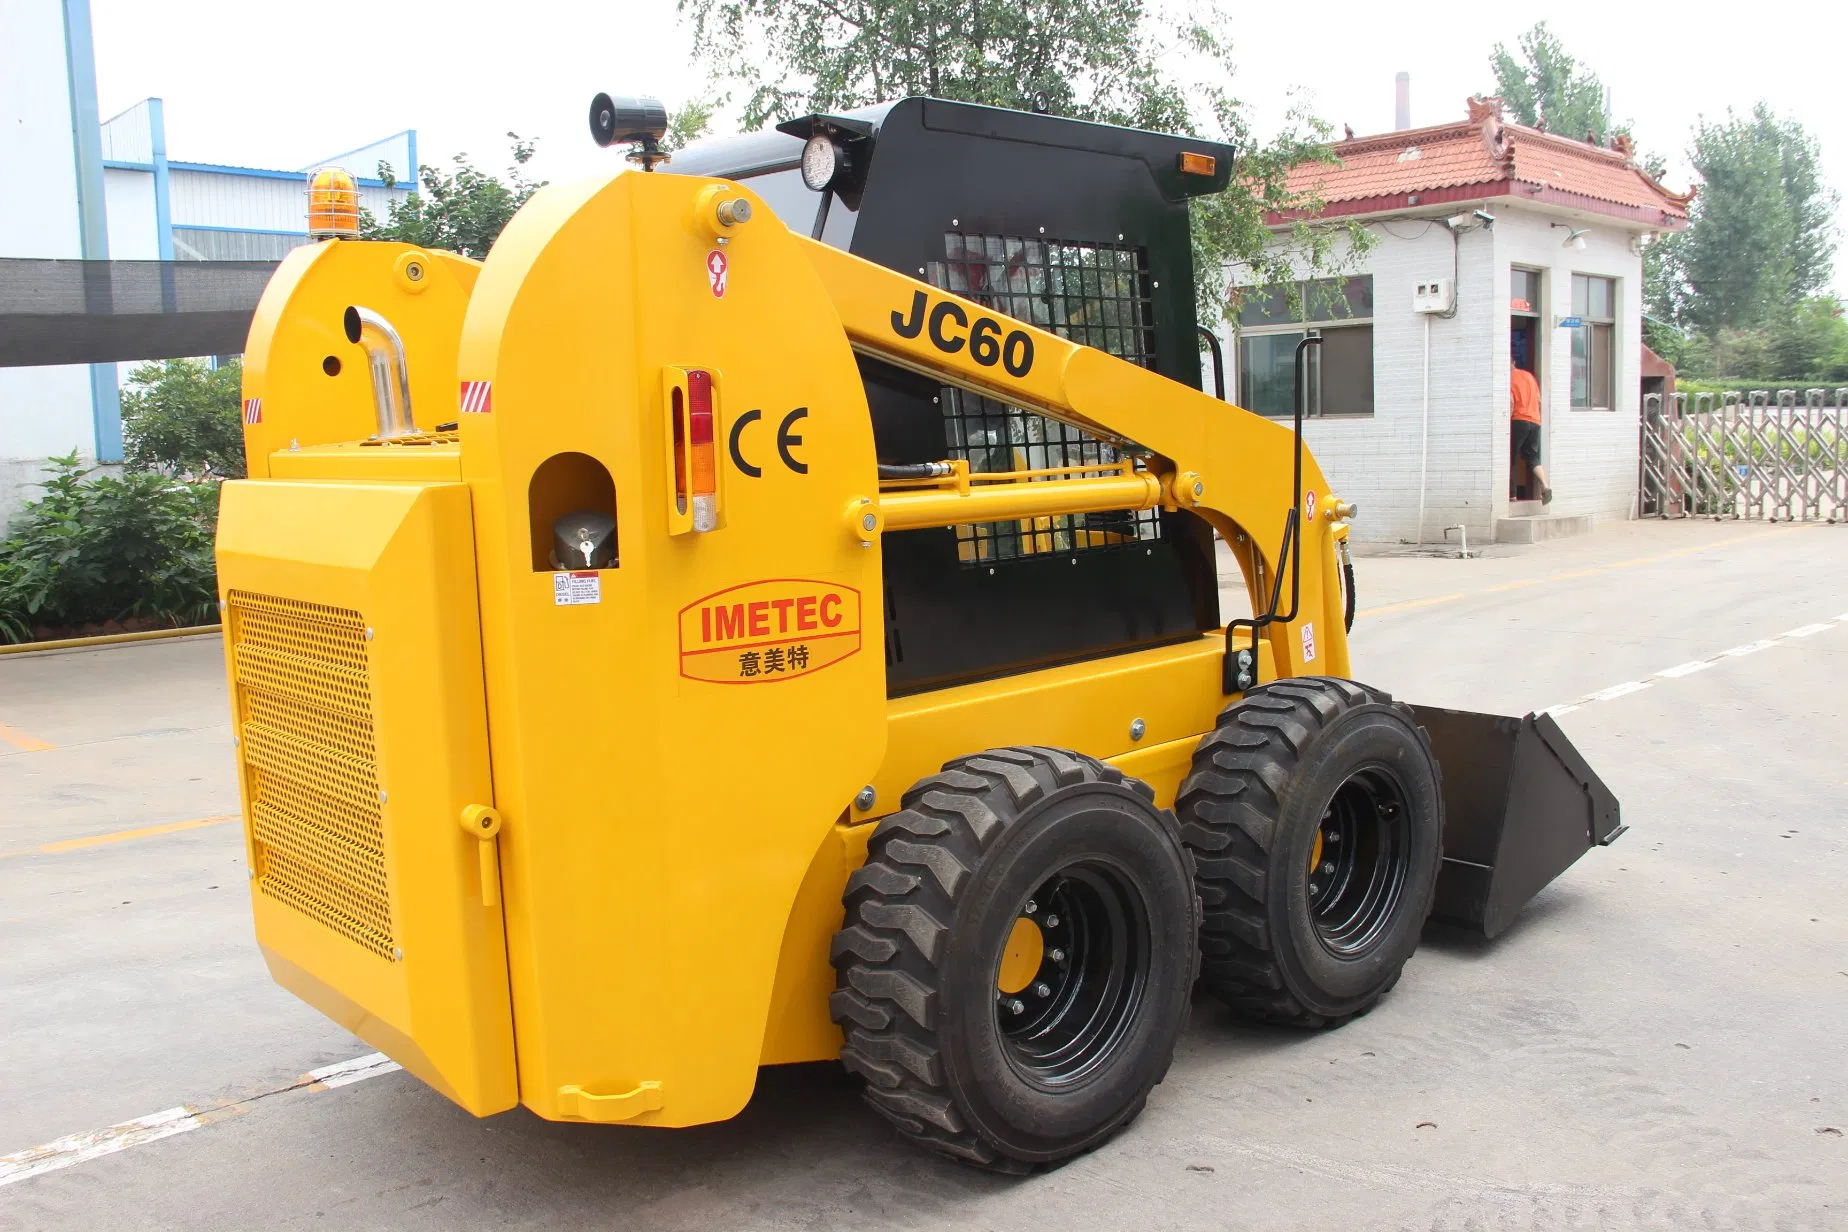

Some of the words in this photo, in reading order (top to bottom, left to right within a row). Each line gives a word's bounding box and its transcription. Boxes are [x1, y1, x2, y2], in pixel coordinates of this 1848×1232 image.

[890, 289, 1035, 379] JC60
[728, 407, 808, 478] CE
[701, 593, 843, 643] IMETEC
[738, 644, 810, 677] 意美特
